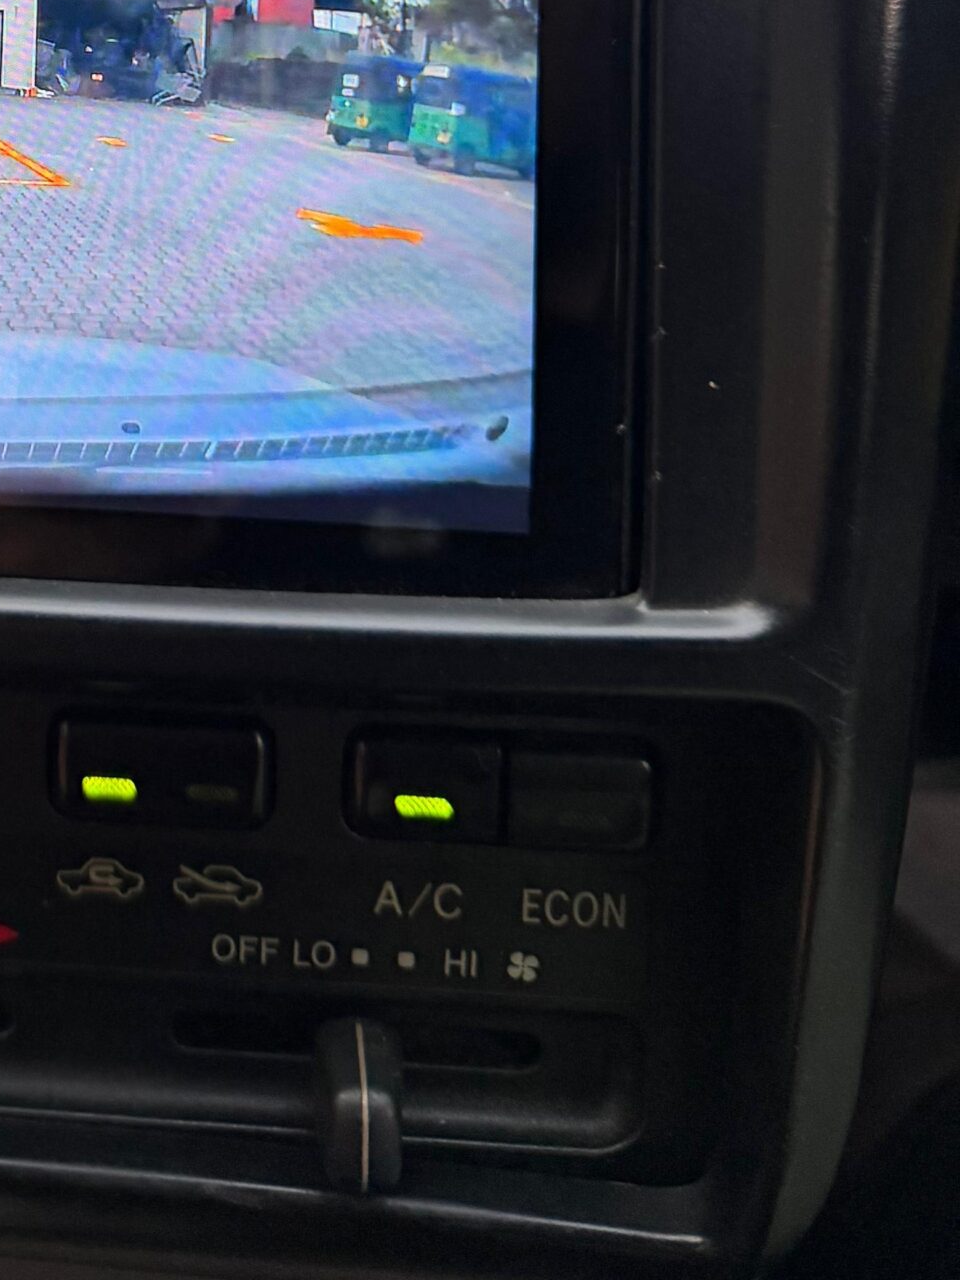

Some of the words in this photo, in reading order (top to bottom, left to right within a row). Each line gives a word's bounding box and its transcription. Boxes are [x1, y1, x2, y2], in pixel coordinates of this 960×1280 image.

[373, 880, 464, 919] A/C
[521, 888, 627, 929] ECON
[211, 933, 279, 965] OFF
[293, 939, 337, 970] LO
[443, 948, 478, 978] HI
